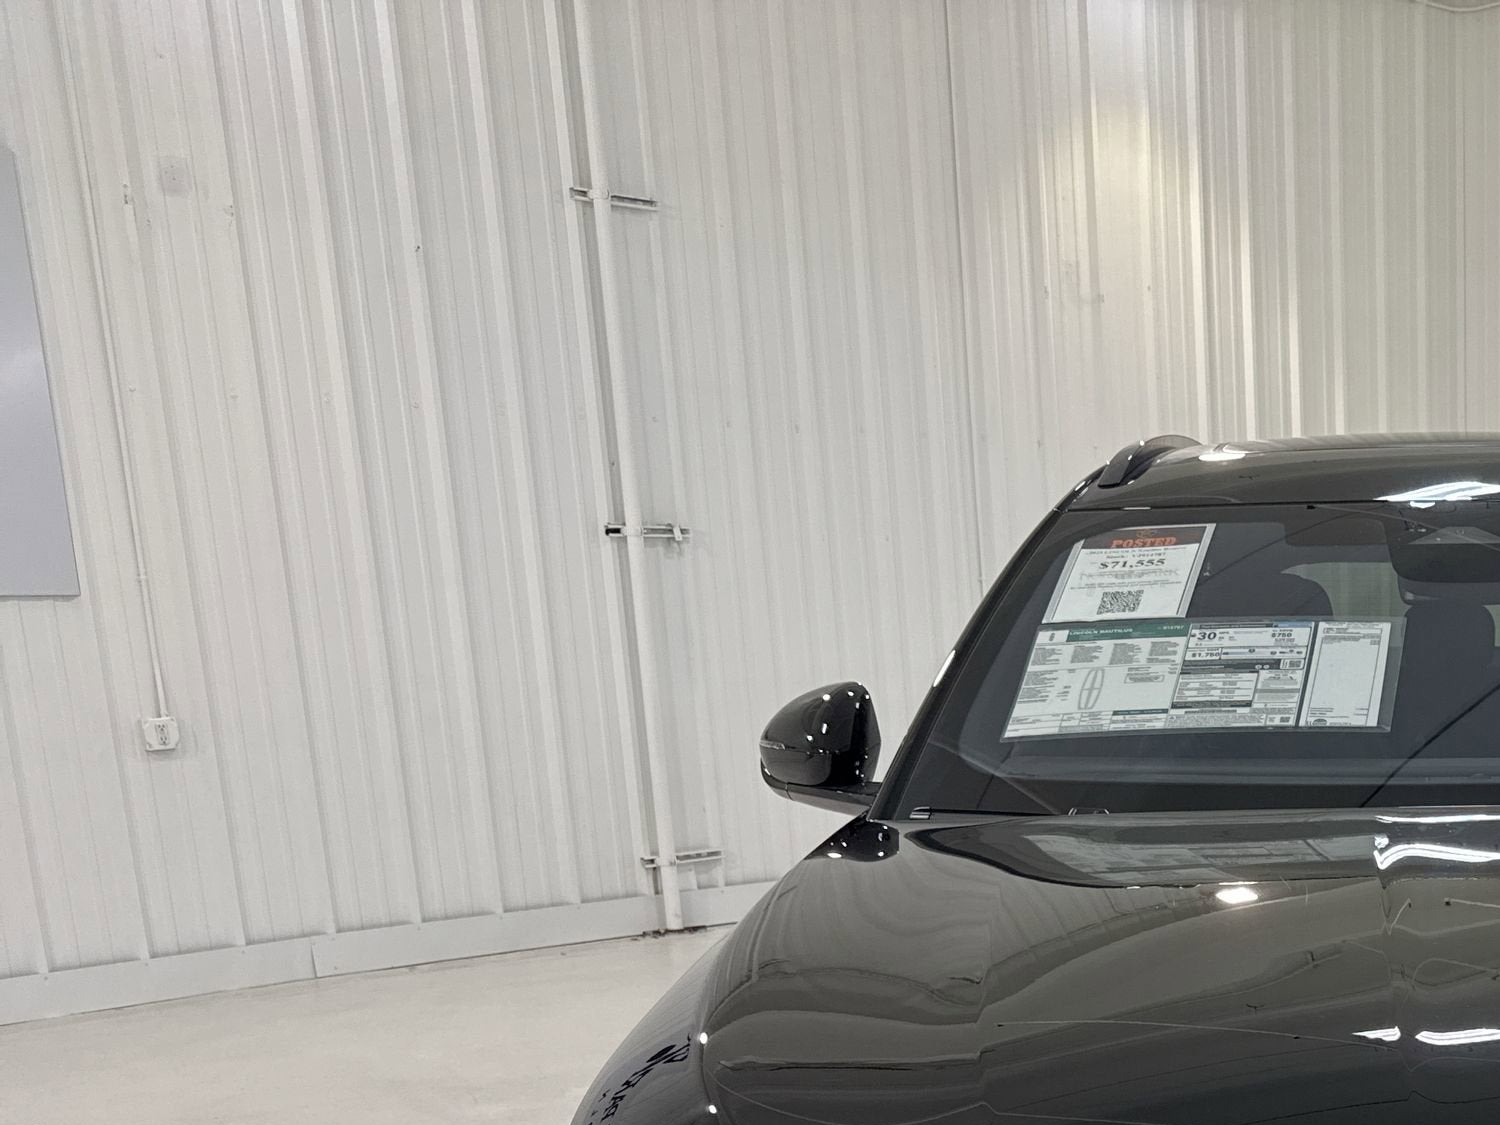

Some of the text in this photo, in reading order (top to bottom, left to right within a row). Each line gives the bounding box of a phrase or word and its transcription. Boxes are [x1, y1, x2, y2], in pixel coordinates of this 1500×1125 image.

[1110, 537, 1177, 549] POSTED
[1099, 558, 1166, 569] $71,555
[1197, 632, 1217, 641] 30
